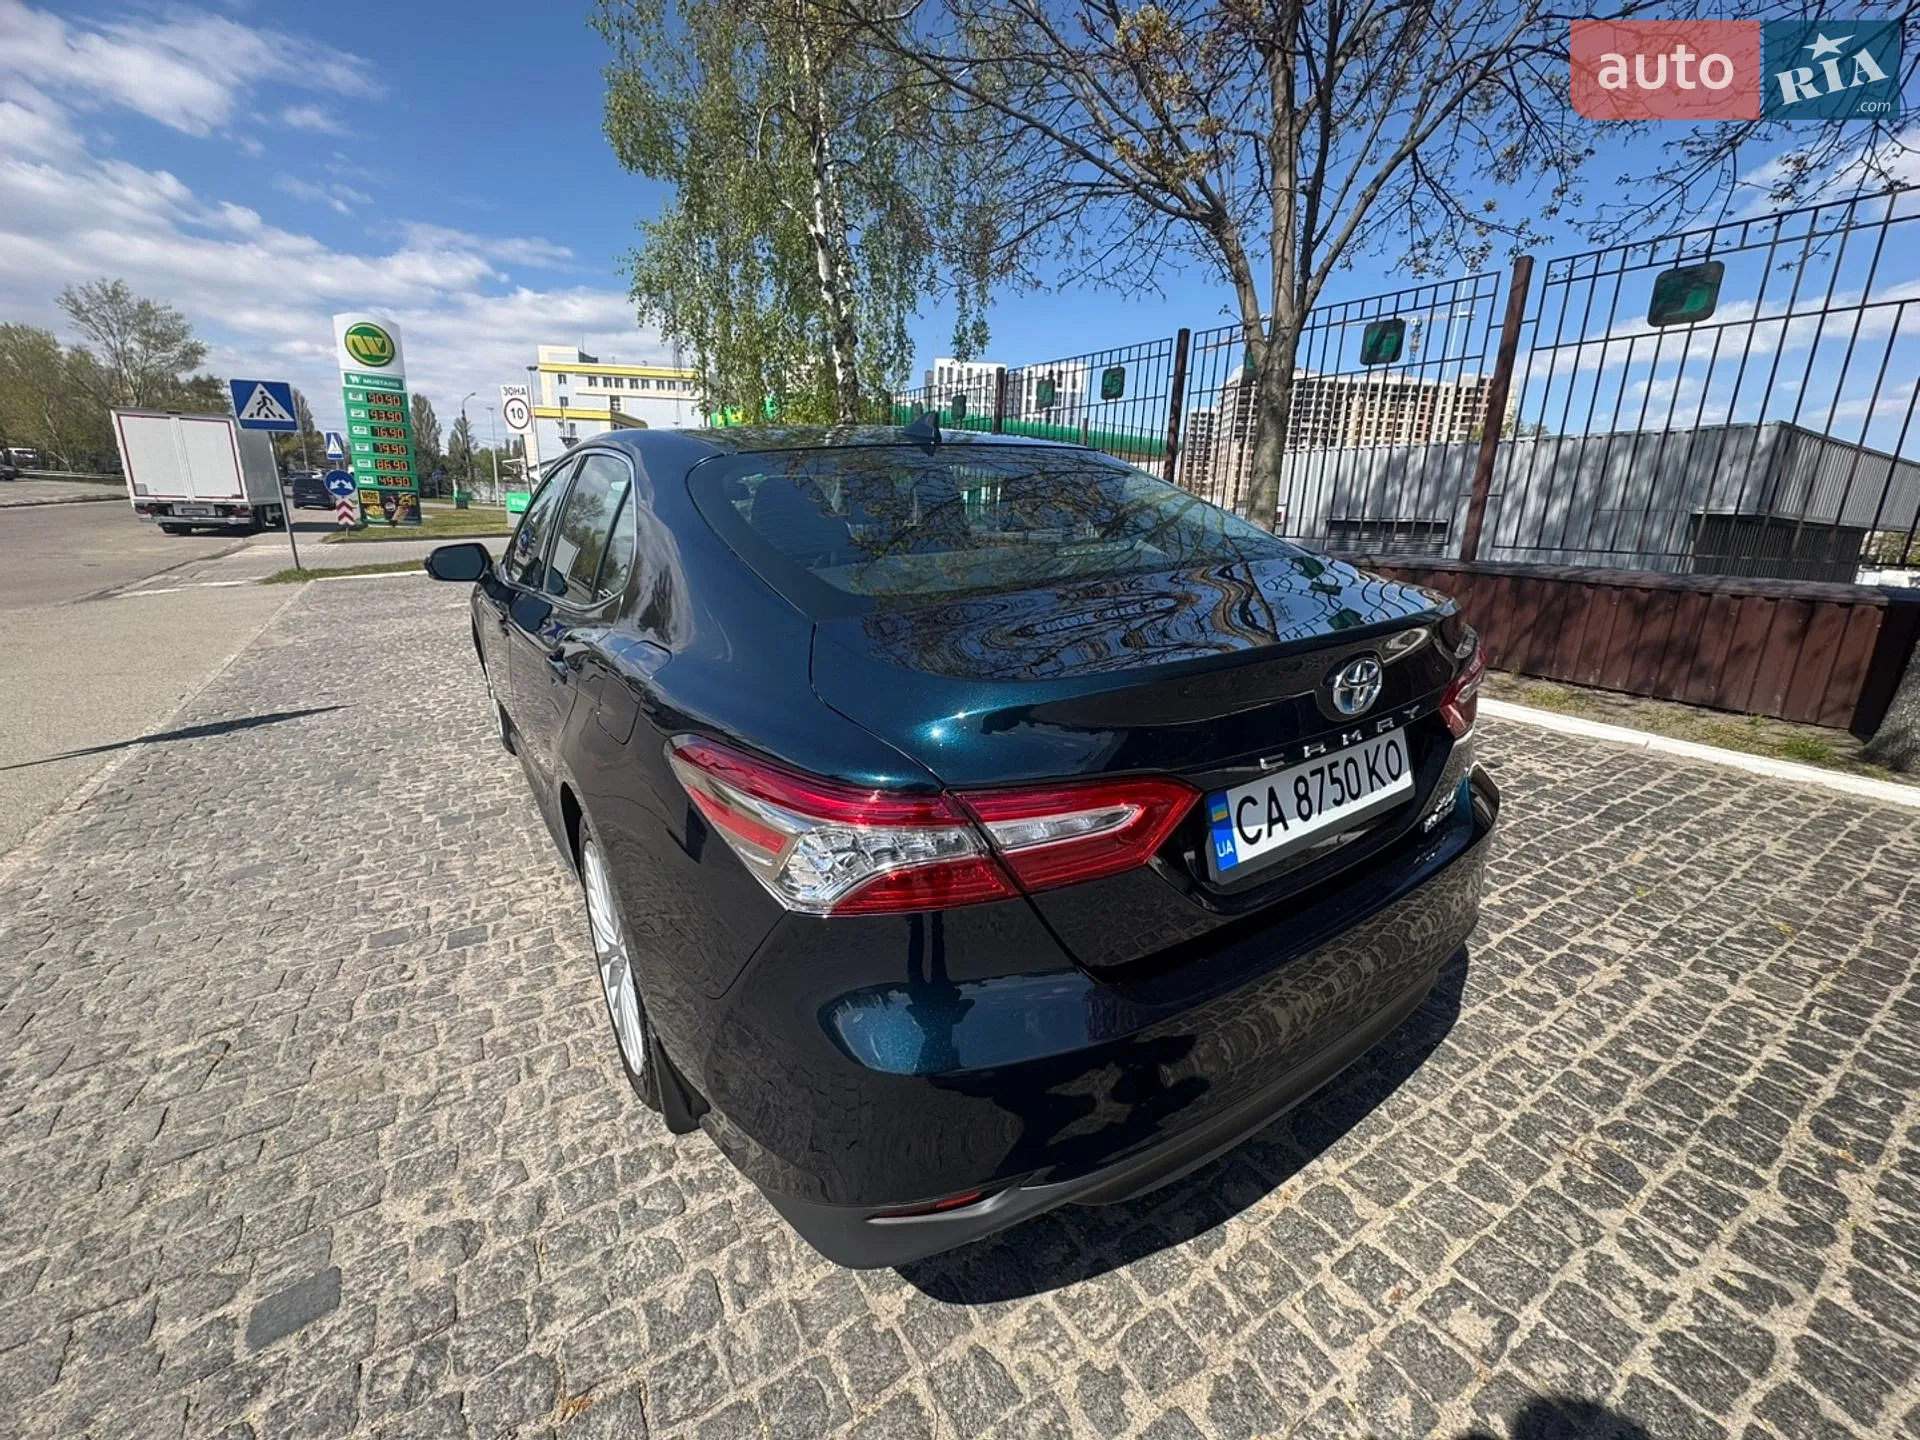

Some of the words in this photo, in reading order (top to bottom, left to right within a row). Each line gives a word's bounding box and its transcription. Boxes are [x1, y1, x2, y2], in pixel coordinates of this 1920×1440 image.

[503, 386, 527, 396] ЗОНА
[511, 407, 524, 420] 10
[1259, 705, 1421, 770] CAMRY
[1236, 785, 1290, 846] CA
[1293, 755, 1362, 823] 8750
[1364, 739, 1402, 793] KO
[1215, 840, 1235, 858] UA
